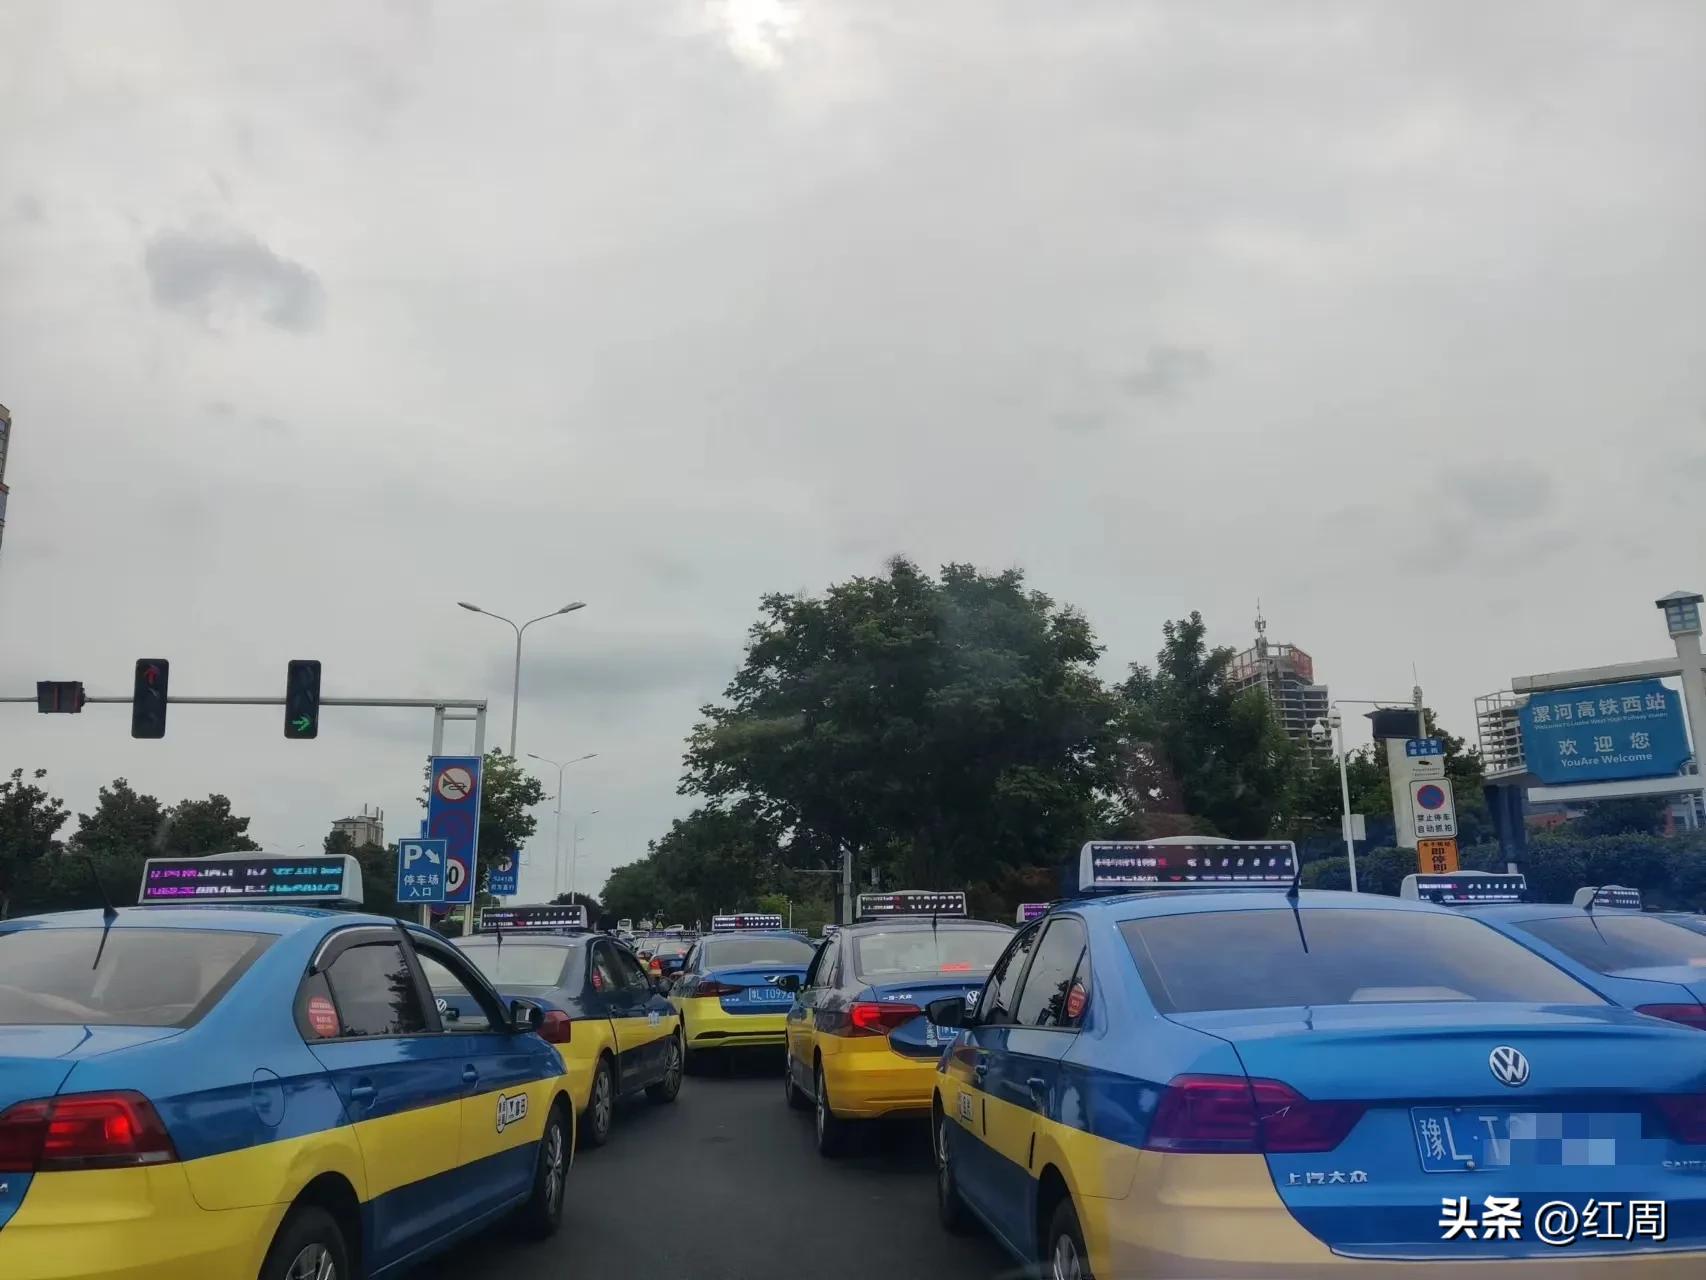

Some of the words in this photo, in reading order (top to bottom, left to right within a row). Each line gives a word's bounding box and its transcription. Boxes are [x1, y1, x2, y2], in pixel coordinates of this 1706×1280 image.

[1532, 692, 1666, 723] 漯河高铁西站
[1559, 731, 1651, 755] 欢迎您
[1600, 752, 1653, 764] Welcome
[1416, 813, 1451, 822] 禁止停车
[1417, 824, 1453, 833] 自动抓拍
[404, 844, 423, 870] P
[403, 874, 440, 886] 停车场
[409, 887, 432, 897] 入口
[1285, 1170, 1368, 1185] 上汽大众
